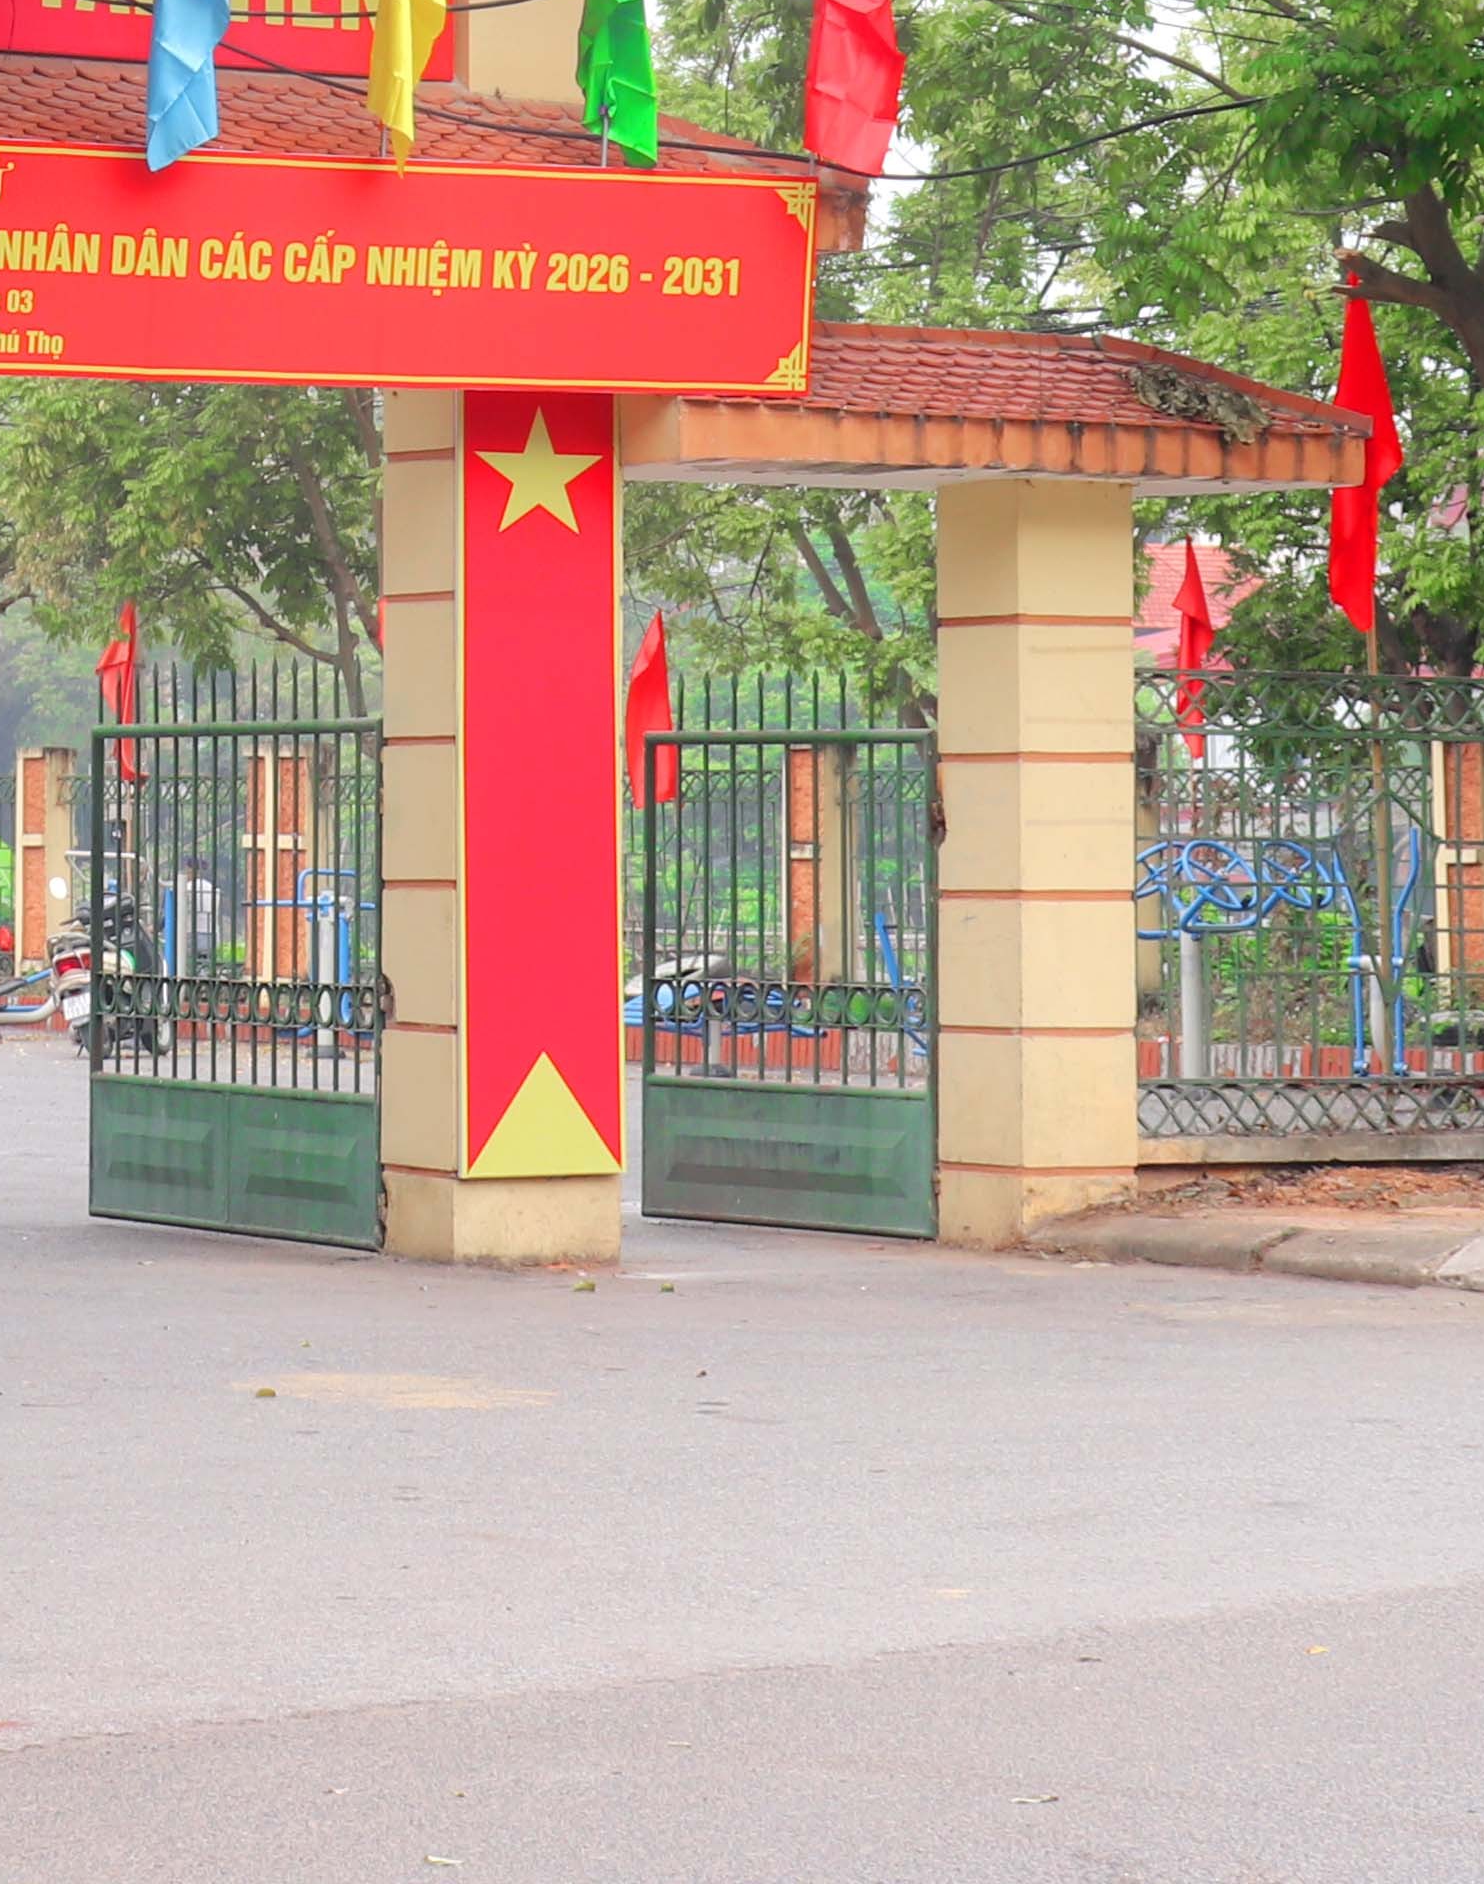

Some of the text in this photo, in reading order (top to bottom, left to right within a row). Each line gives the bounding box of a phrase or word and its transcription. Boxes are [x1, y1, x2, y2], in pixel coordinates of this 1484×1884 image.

[110, 228, 189, 279] DÂN
[198, 231, 273, 282] CÁC
[283, 229, 357, 284] CẤP
[366, 239, 483, 297] NHIỆM
[492, 242, 538, 290] KỲ
[545, 252, 631, 294] 2026
[639, 272, 654, 283] -
[661, 256, 741, 297] 2031
[6, 290, 34, 314] 03
[26, 330, 64, 360] Thọ
